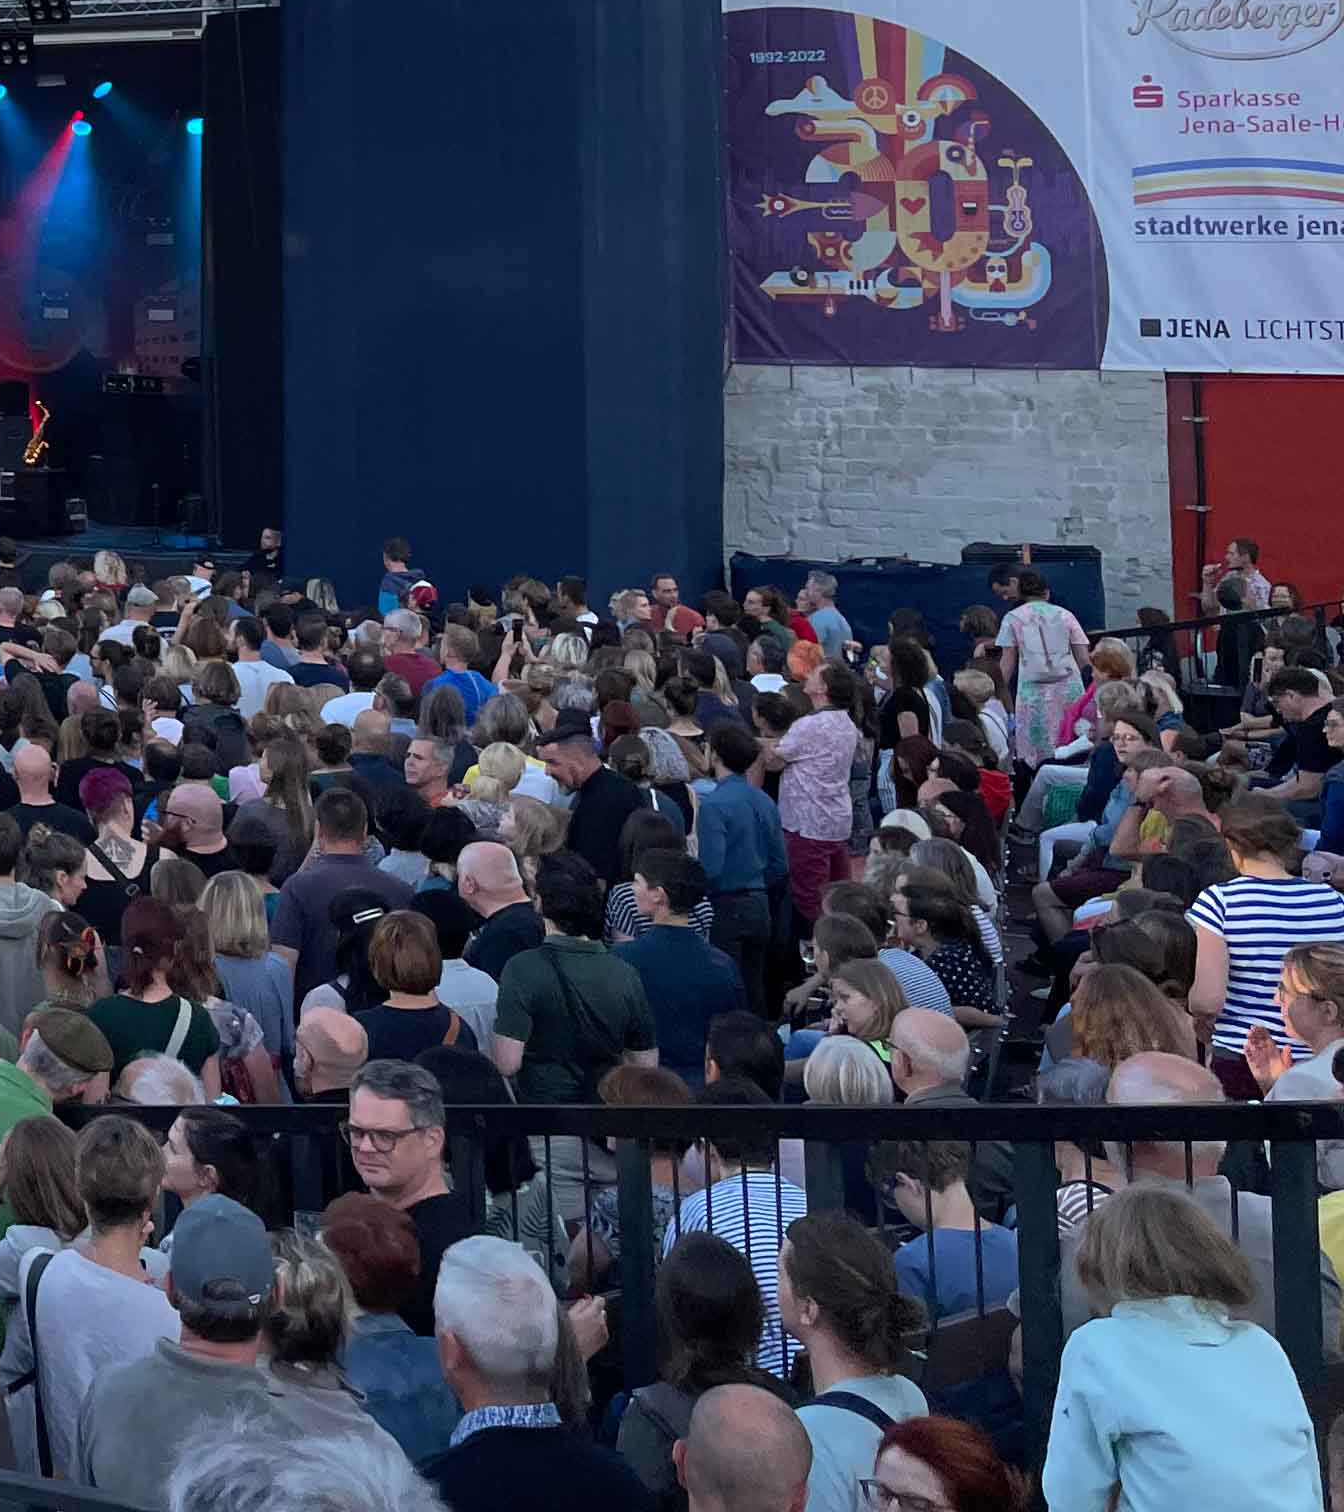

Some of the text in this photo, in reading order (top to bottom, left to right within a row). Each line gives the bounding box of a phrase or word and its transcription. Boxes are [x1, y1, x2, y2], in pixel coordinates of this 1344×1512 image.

[1177, 88, 1301, 112] Sparkasse
[1179, 112, 1344, 135] Jena-Saale-H
[1135, 215, 1289, 236] stadtwerke
[1166, 319, 1231, 338] JENA
